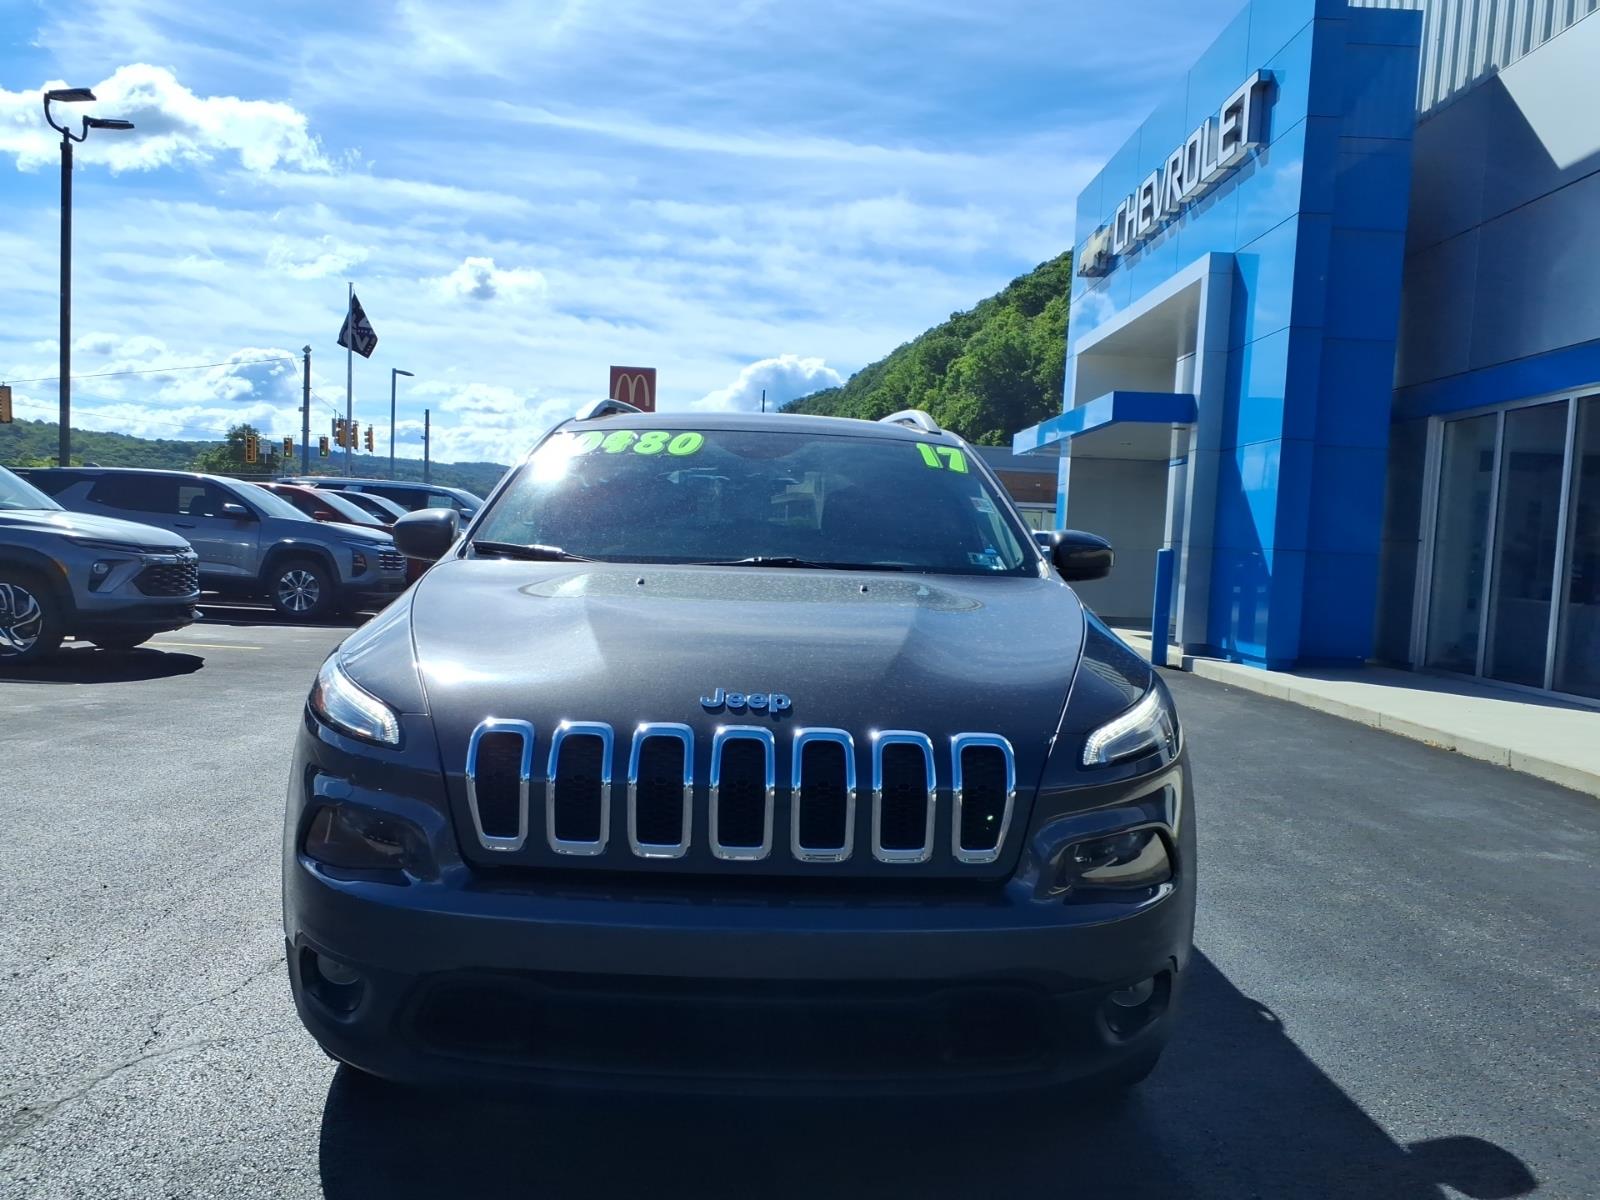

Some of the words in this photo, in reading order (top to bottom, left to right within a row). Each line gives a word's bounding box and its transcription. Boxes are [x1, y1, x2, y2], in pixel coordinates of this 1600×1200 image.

[1112, 69, 1267, 256] CHEVROLET
[562, 430, 704, 456] 0480
[916, 442, 968, 474] 17
[700, 687, 792, 713] Jeep
